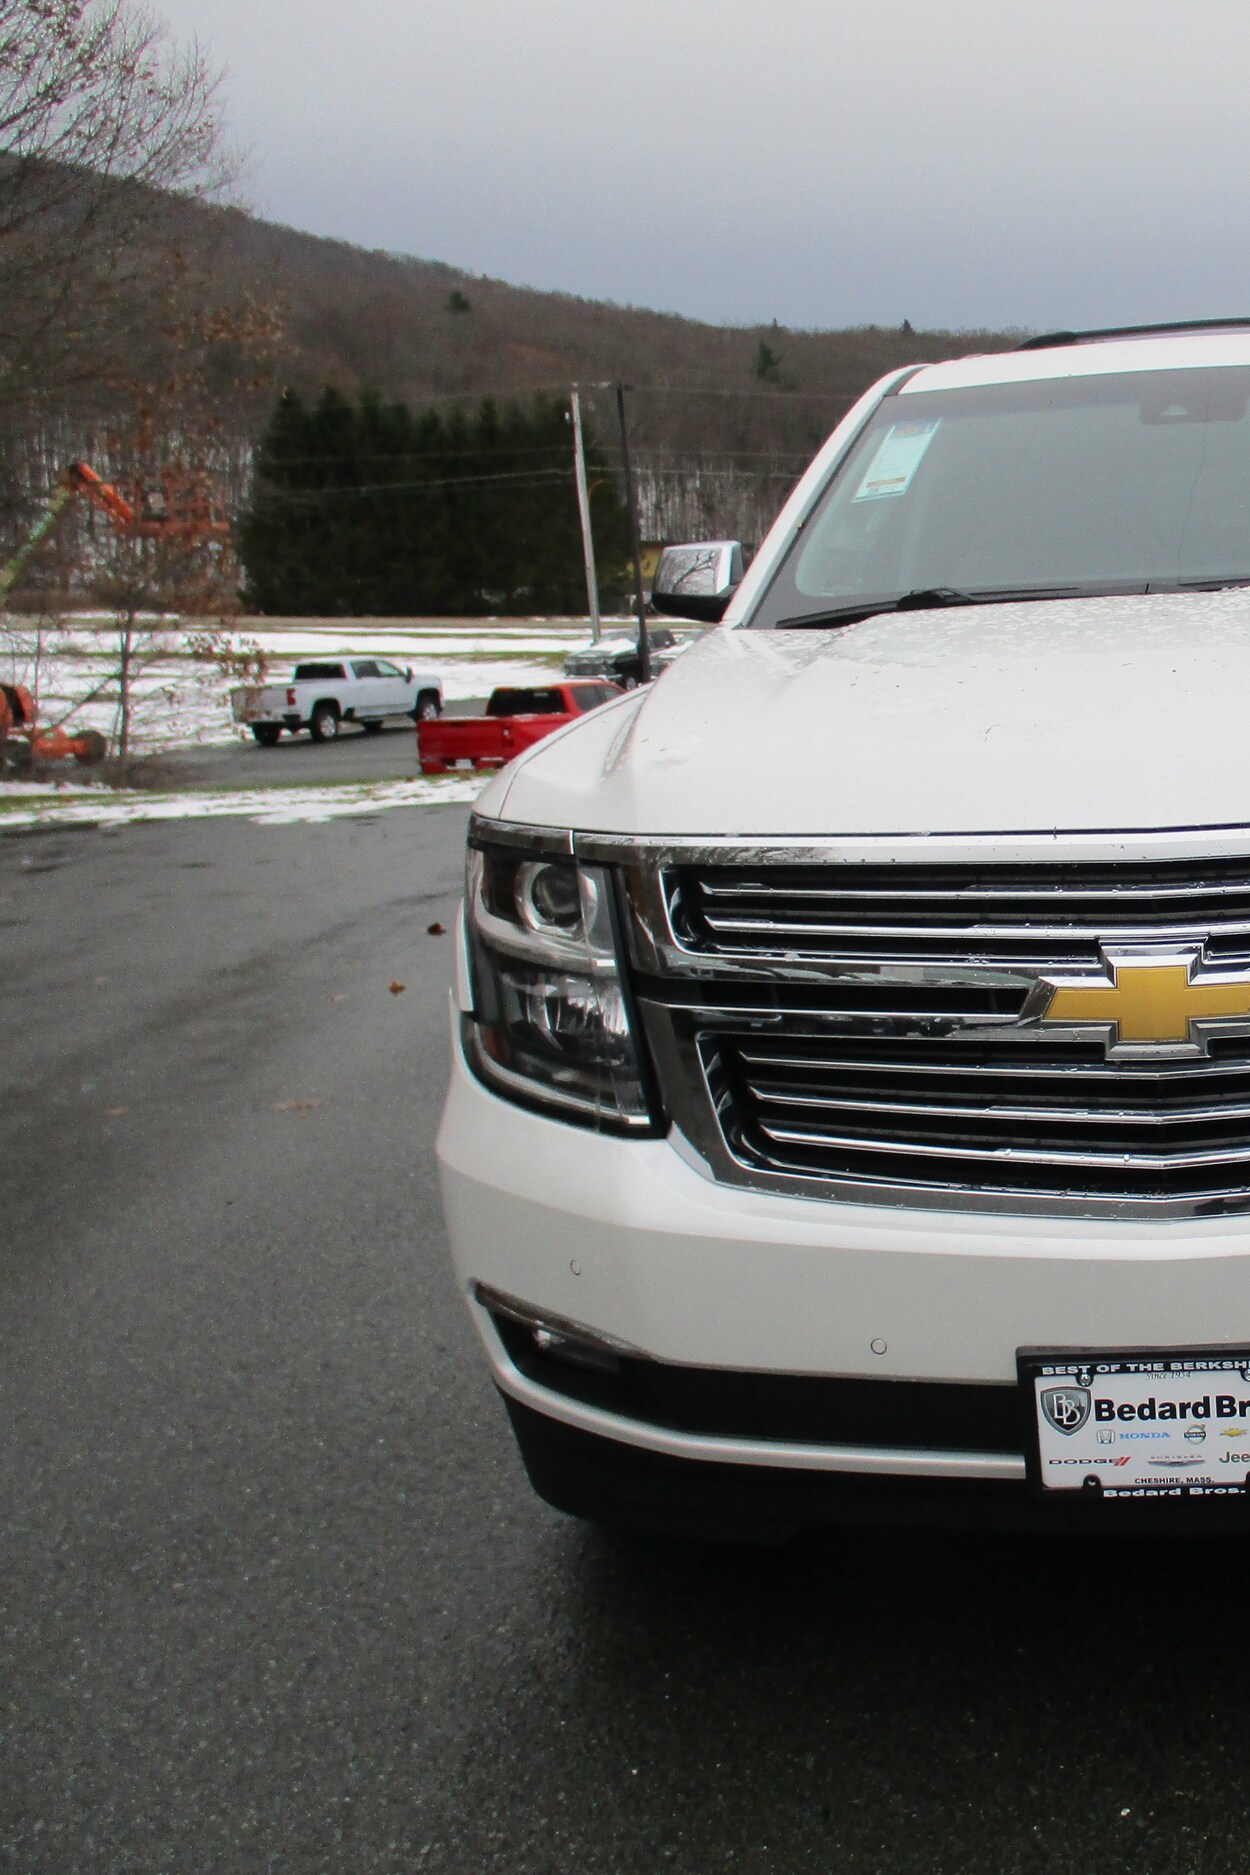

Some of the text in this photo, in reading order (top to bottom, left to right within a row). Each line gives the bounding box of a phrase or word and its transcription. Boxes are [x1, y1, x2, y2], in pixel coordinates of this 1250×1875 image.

[1042, 1365, 1091, 1375] BEST
[1096, 1364, 1121, 1373] OF
[1127, 1362, 1164, 1372] THE
[1094, 1396, 1211, 1421] Bedard
[1103, 1487, 1246, 1497] Bedard Bros.
